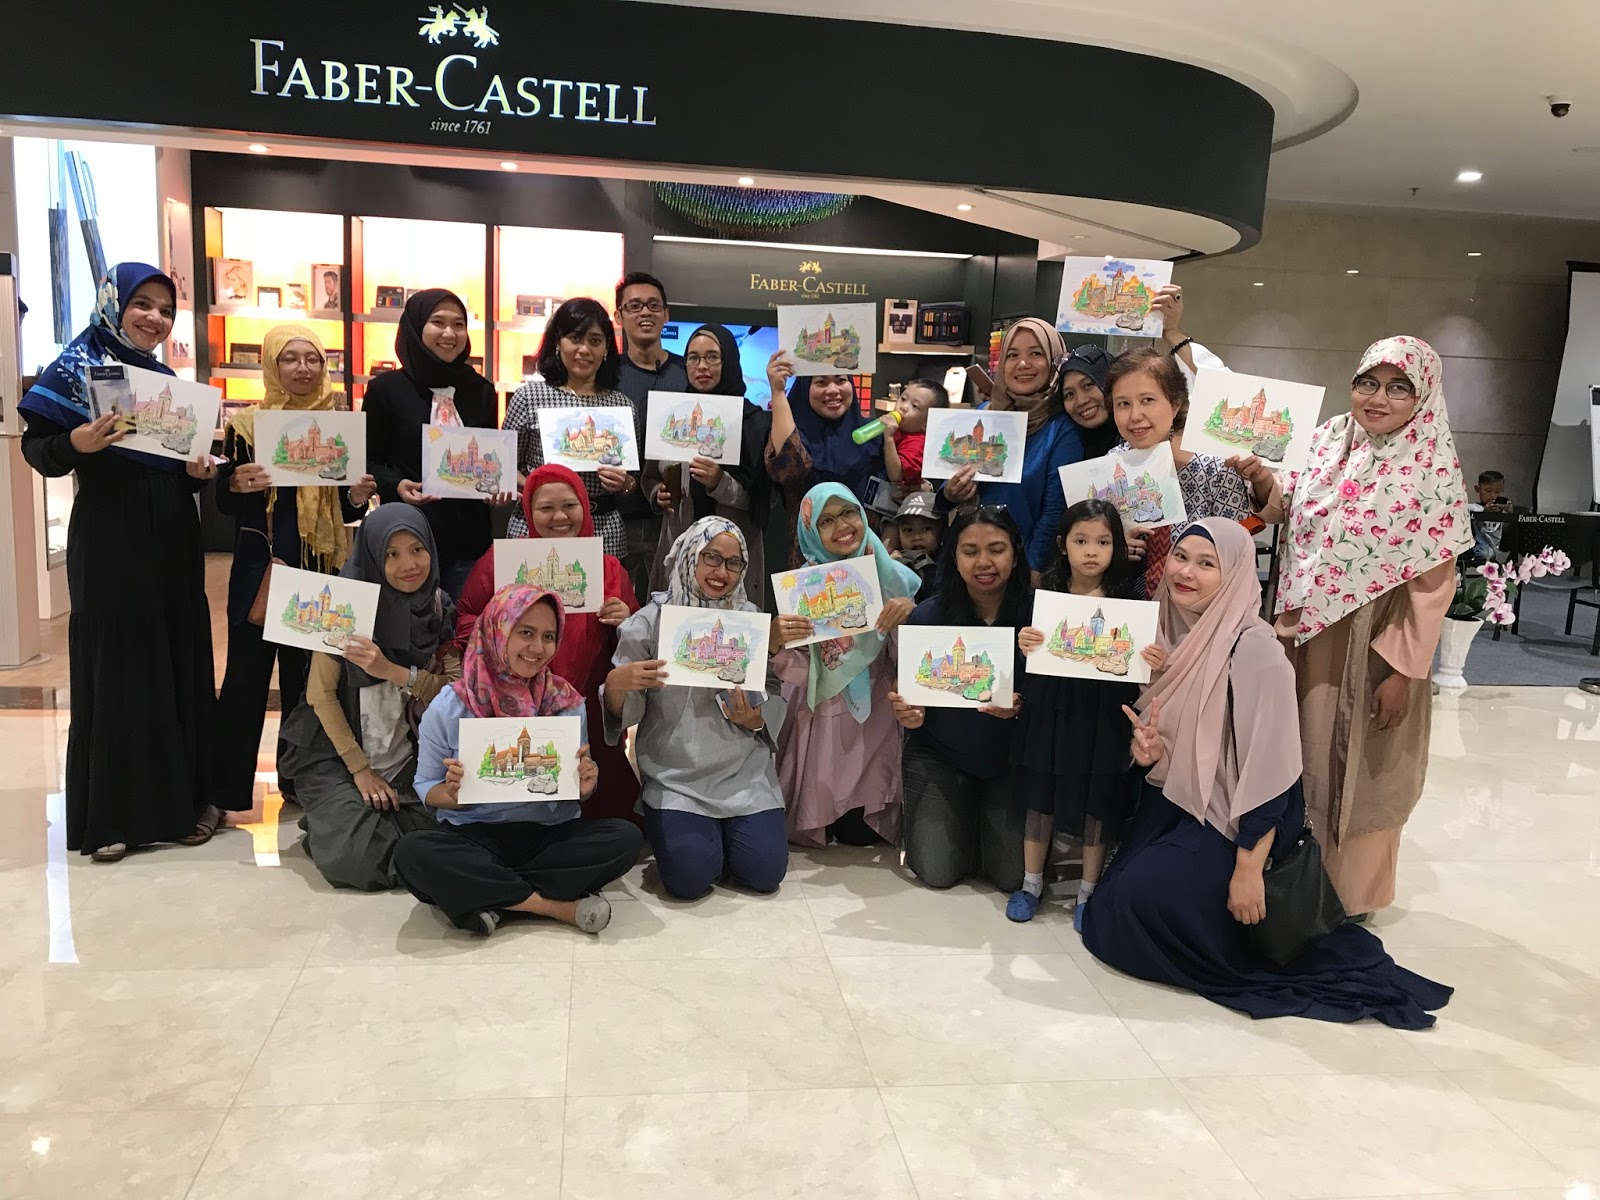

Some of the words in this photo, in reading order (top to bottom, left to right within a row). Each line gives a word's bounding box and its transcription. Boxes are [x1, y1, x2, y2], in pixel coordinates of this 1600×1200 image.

[249, 38, 657, 126] FABER-CASTELL
[430, 117, 461, 132] since
[463, 119, 492, 134] 1761
[750, 273, 869, 296] FABER-CASTELL
[1518, 514, 1566, 524] FABER-CASTELL
